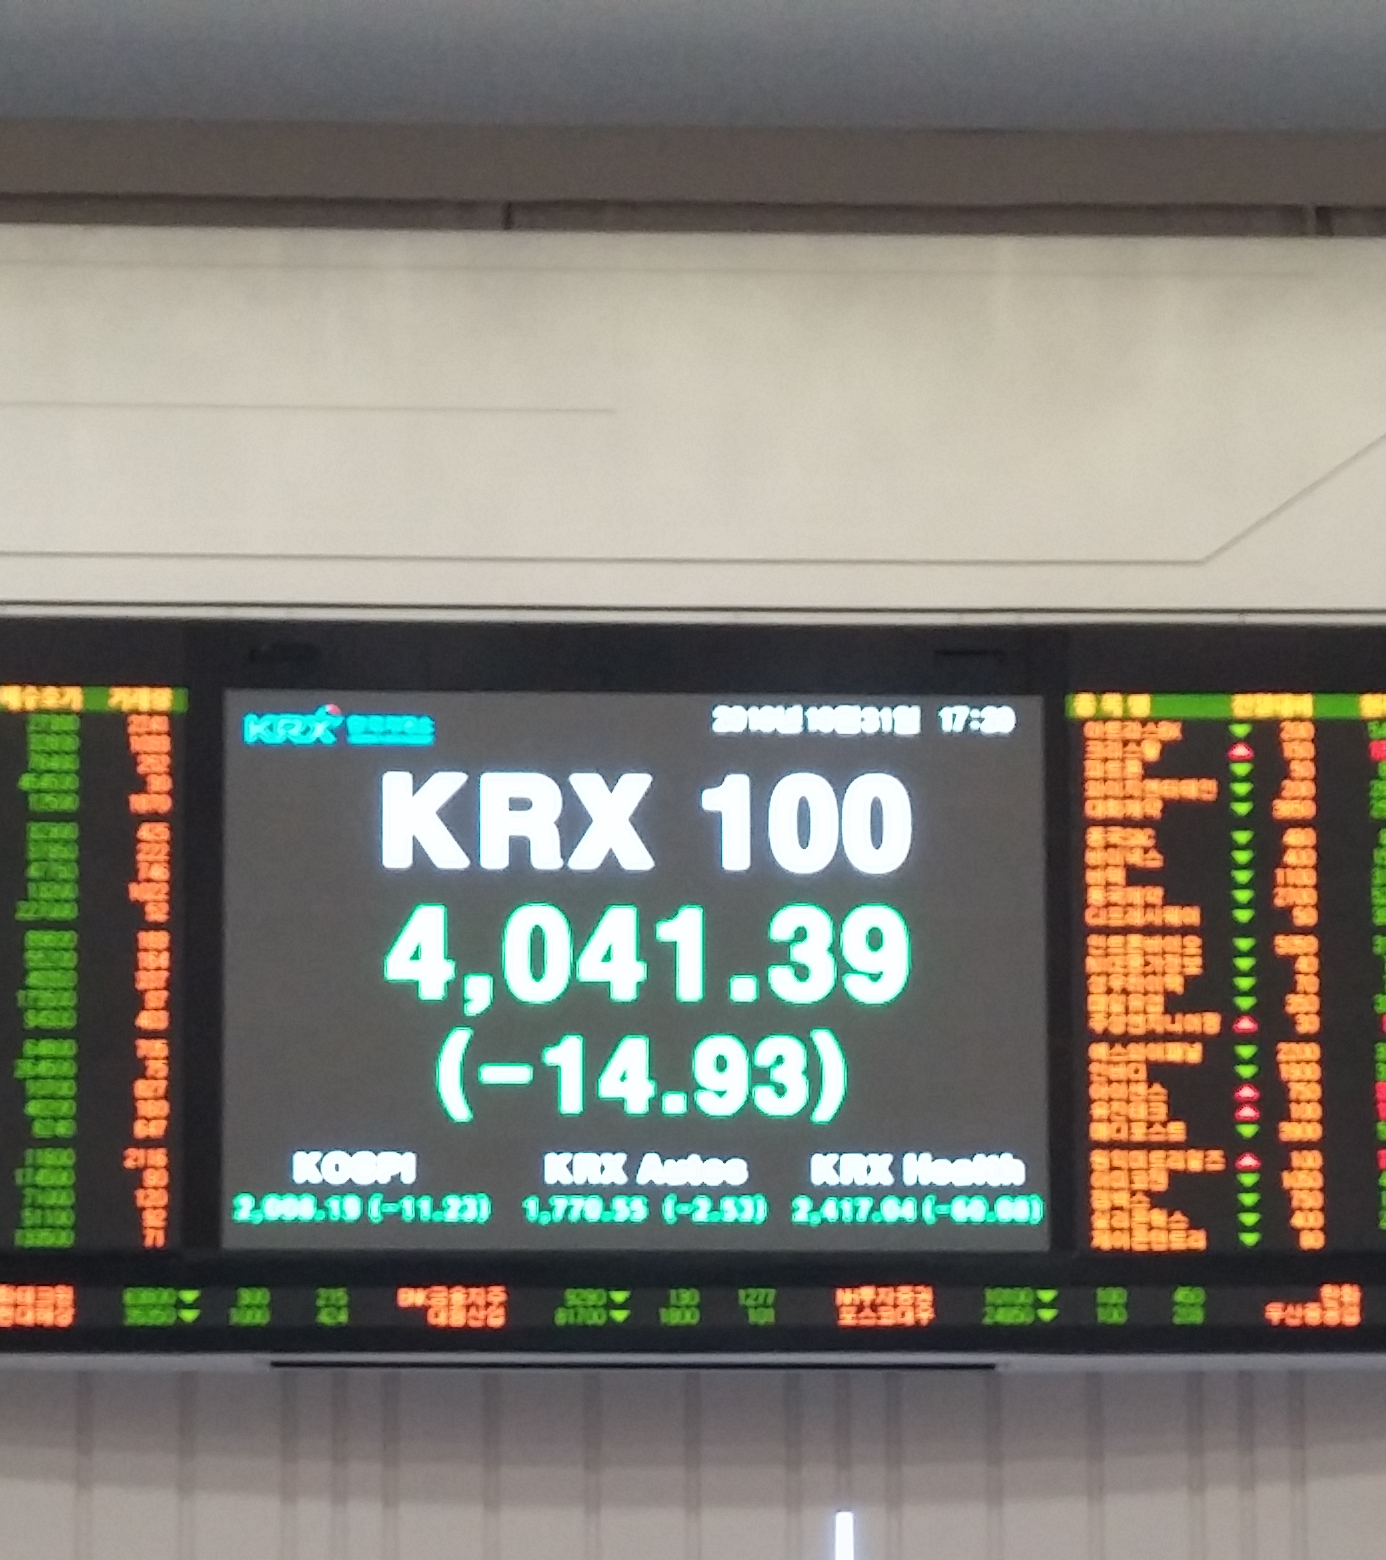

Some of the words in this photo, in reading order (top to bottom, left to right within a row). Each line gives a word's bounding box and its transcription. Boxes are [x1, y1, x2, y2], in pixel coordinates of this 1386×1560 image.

[381, 771, 656, 871] KRX
[701, 772, 913, 875] 100
[384, 903, 912, 1016] 4,041.39
[436, 1027, 848, 1124] (-14.93)
[293, 1150, 416, 1185] KOSPI
[544, 1152, 628, 1185] KRX
[810, 1153, 894, 1186] KRX
